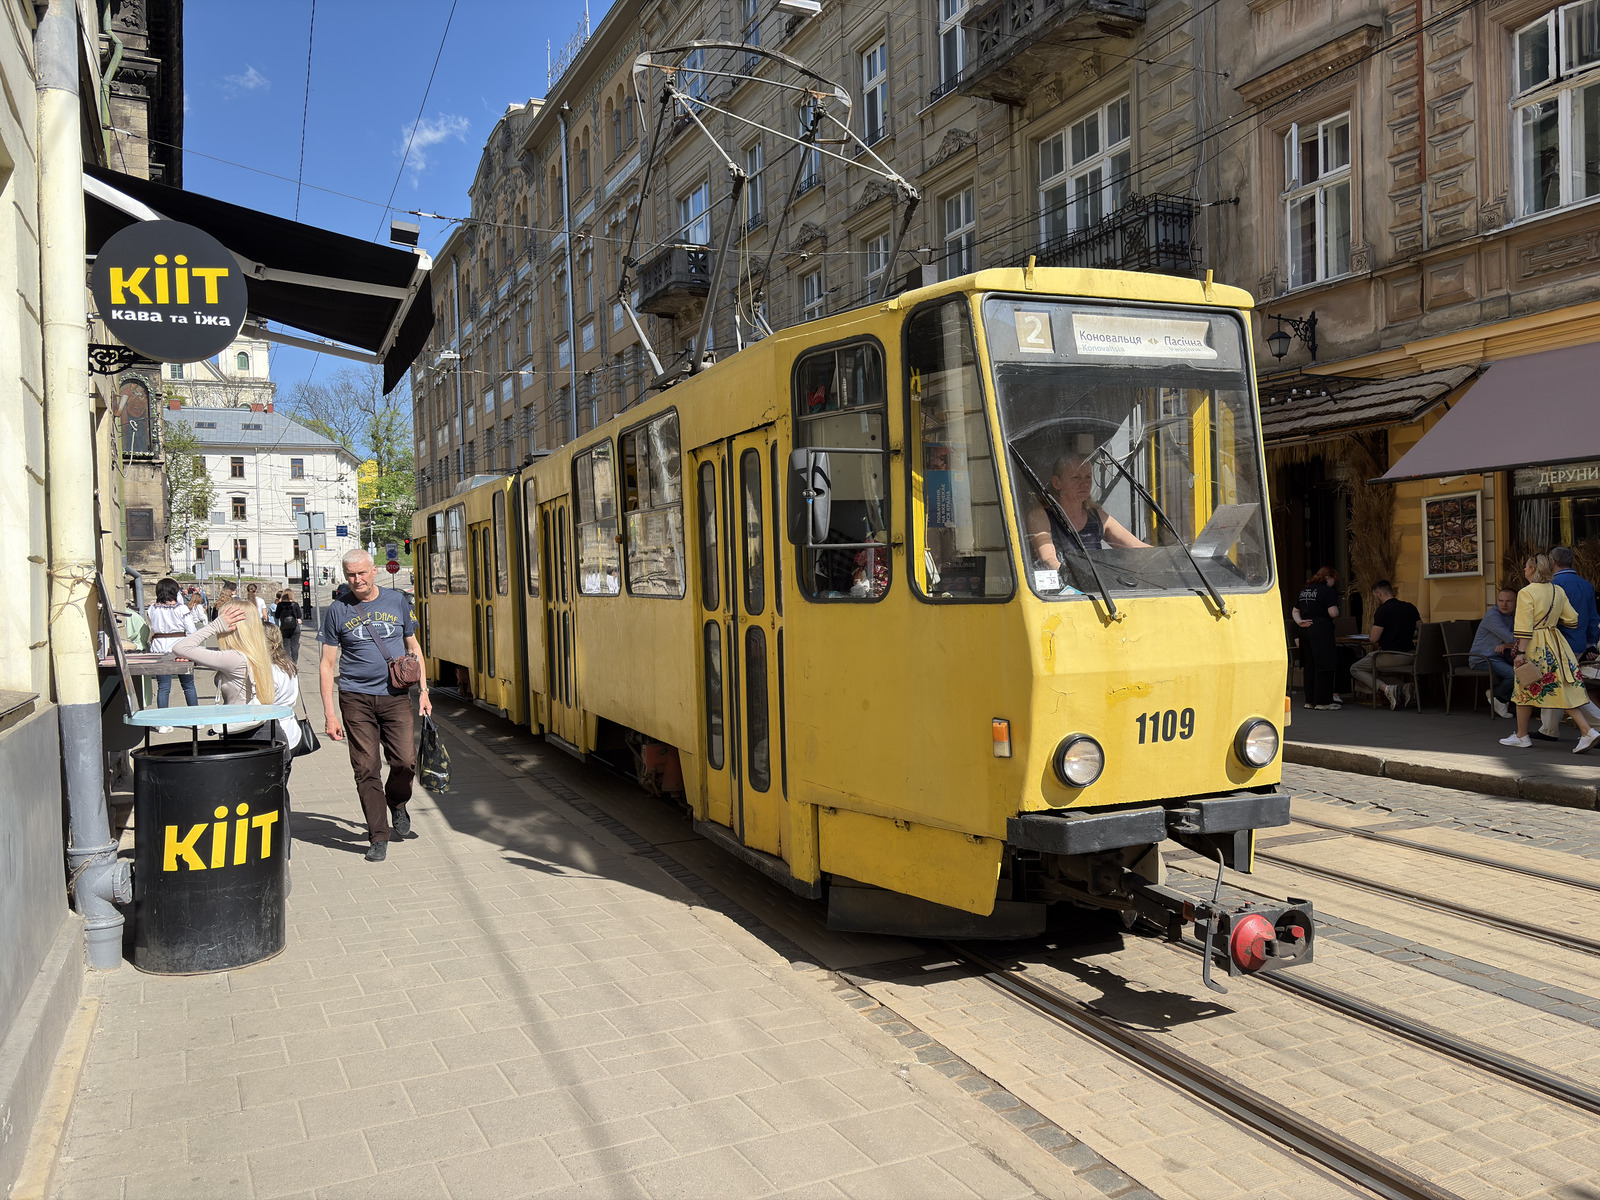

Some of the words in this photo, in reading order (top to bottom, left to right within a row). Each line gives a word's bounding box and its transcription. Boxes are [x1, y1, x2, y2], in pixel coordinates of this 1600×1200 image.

[111, 309, 163, 323] кава
[169, 315, 188, 324] та
[193, 311, 231, 327] їжа
[1024, 315, 1045, 345] 2
[1079, 330, 1142, 346] Коновальця
[1164, 335, 1203, 347] Пасічна
[1538, 466, 1599, 488] ДЕРУНИ
[345, 612, 371, 630] NOTE
[374, 611, 398, 624] DAME
[1135, 707, 1196, 745] 1109
